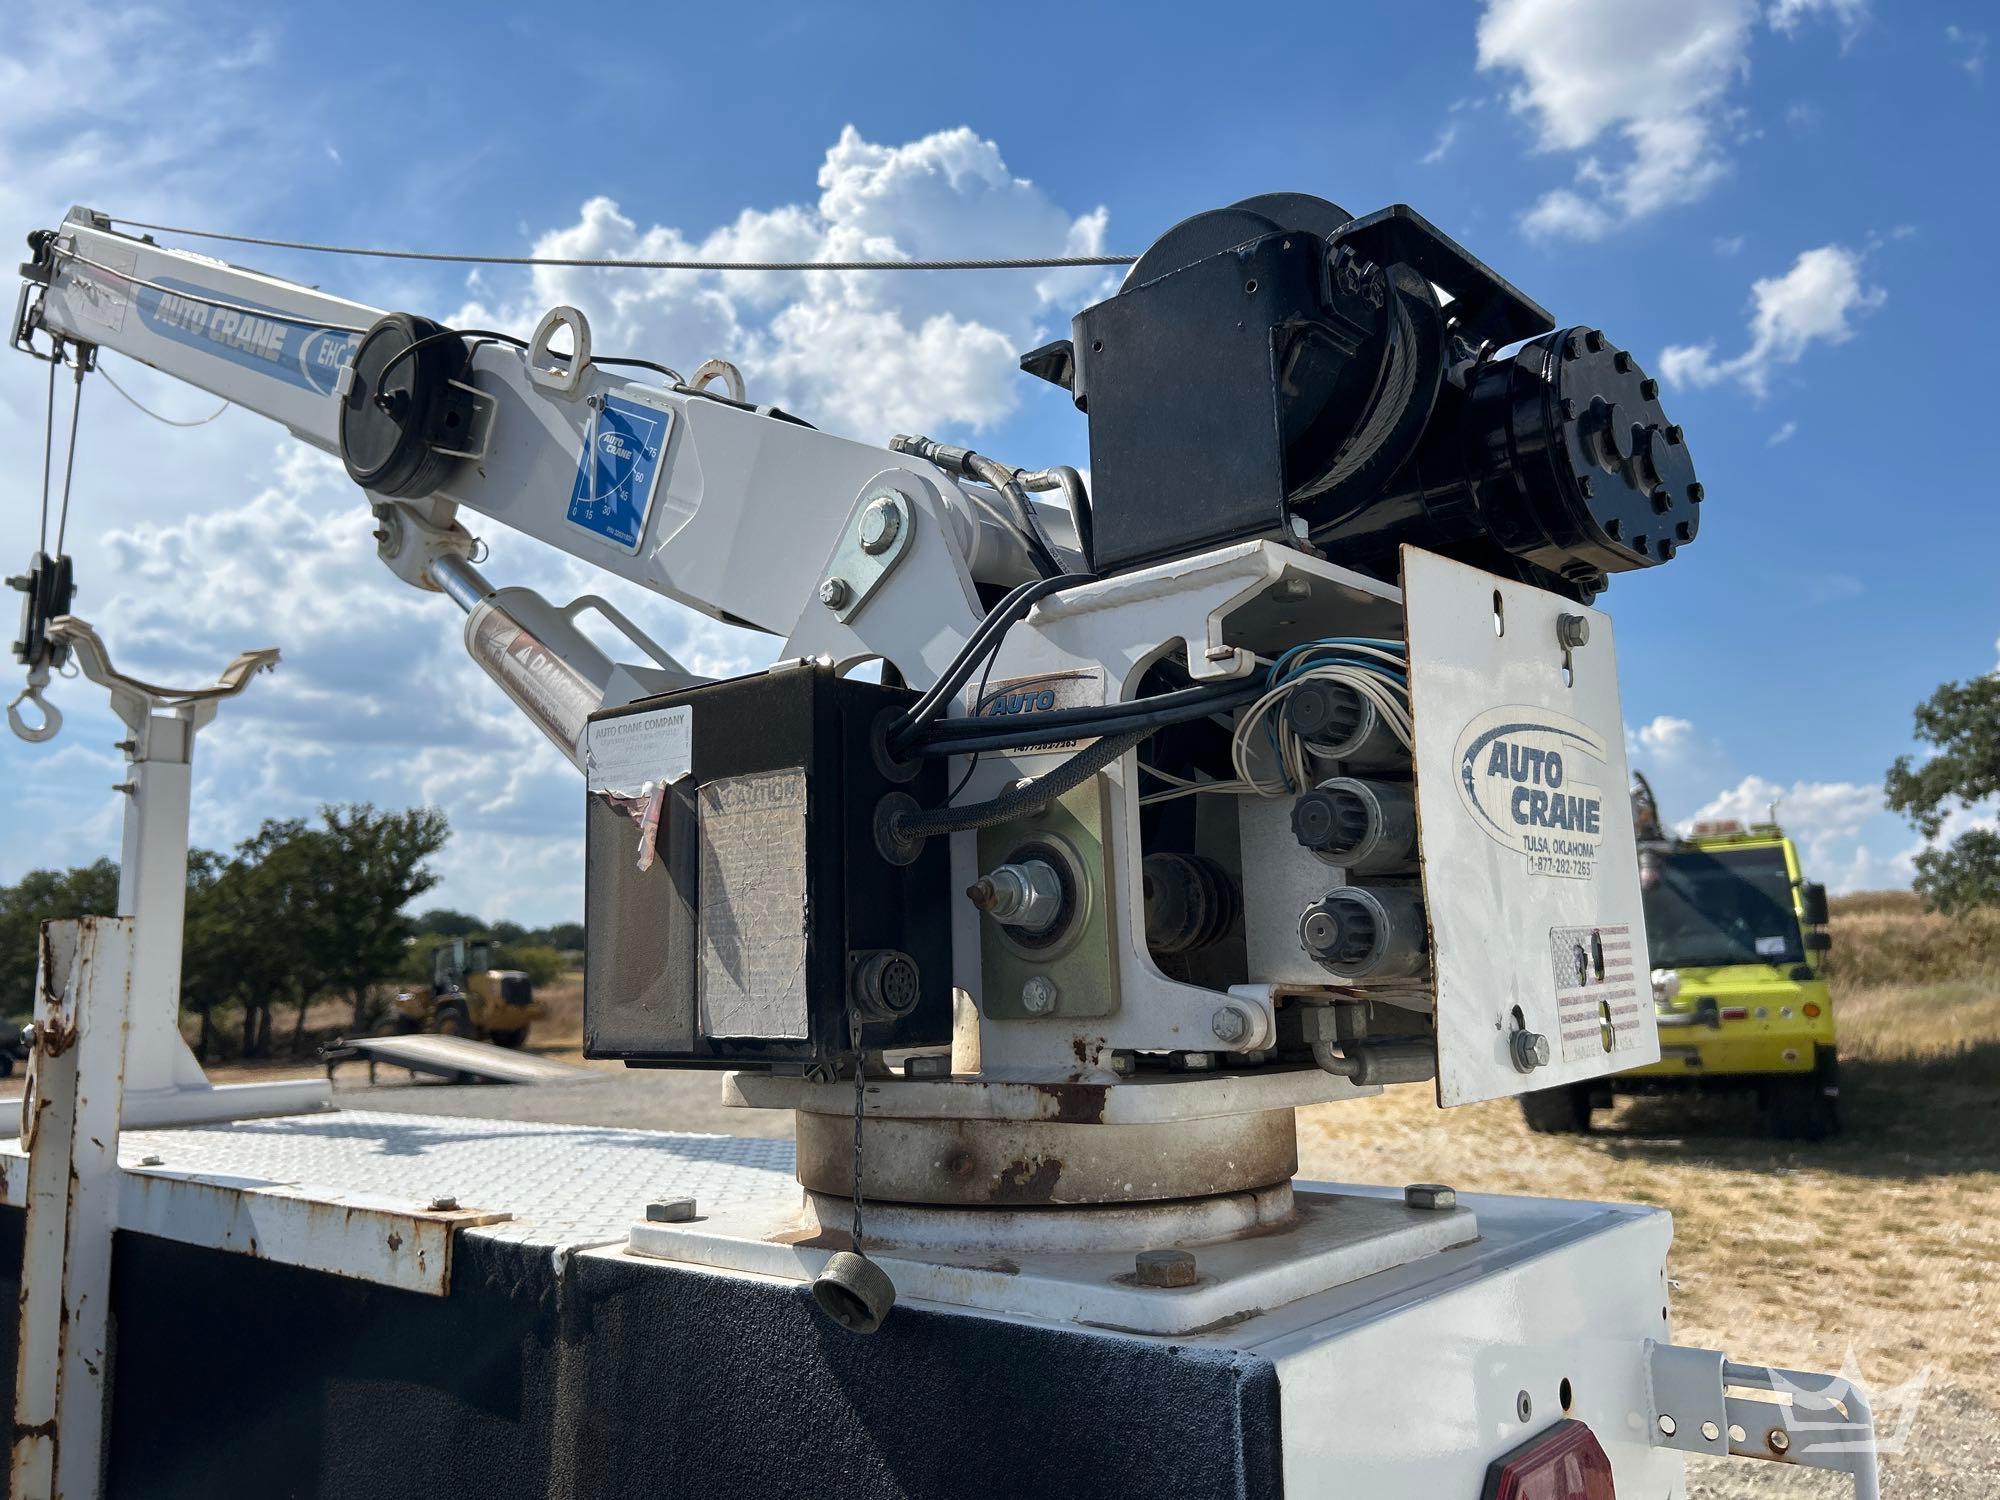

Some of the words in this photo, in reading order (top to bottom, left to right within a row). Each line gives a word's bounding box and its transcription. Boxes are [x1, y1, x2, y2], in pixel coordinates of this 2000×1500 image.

[153, 294, 210, 335] AUTO
[209, 309, 288, 362] CRANE
[603, 434, 625, 447] AUTO
[606, 445, 632, 459] CRANE
[648, 447, 658, 458] 75
[635, 472, 645, 483] 60
[620, 491, 629, 501] 45
[572, 506, 578, 517] 0
[585, 509, 593, 520] 15
[602, 505, 611, 516] 30
[991, 690, 1055, 716] AUTO
[595, 726, 617, 739] AUTO
[617, 721, 643, 735] CRANE
[644, 714, 685, 731] COMPANY
[1487, 740, 1563, 788] AUTO
[1511, 785, 1600, 834] CRANE
[1523, 835, 1551, 856] TULSA,
[1552, 838, 1595, 858] OKLAHOMA
[1529, 855, 1591, 876] 1-877-282-7263
